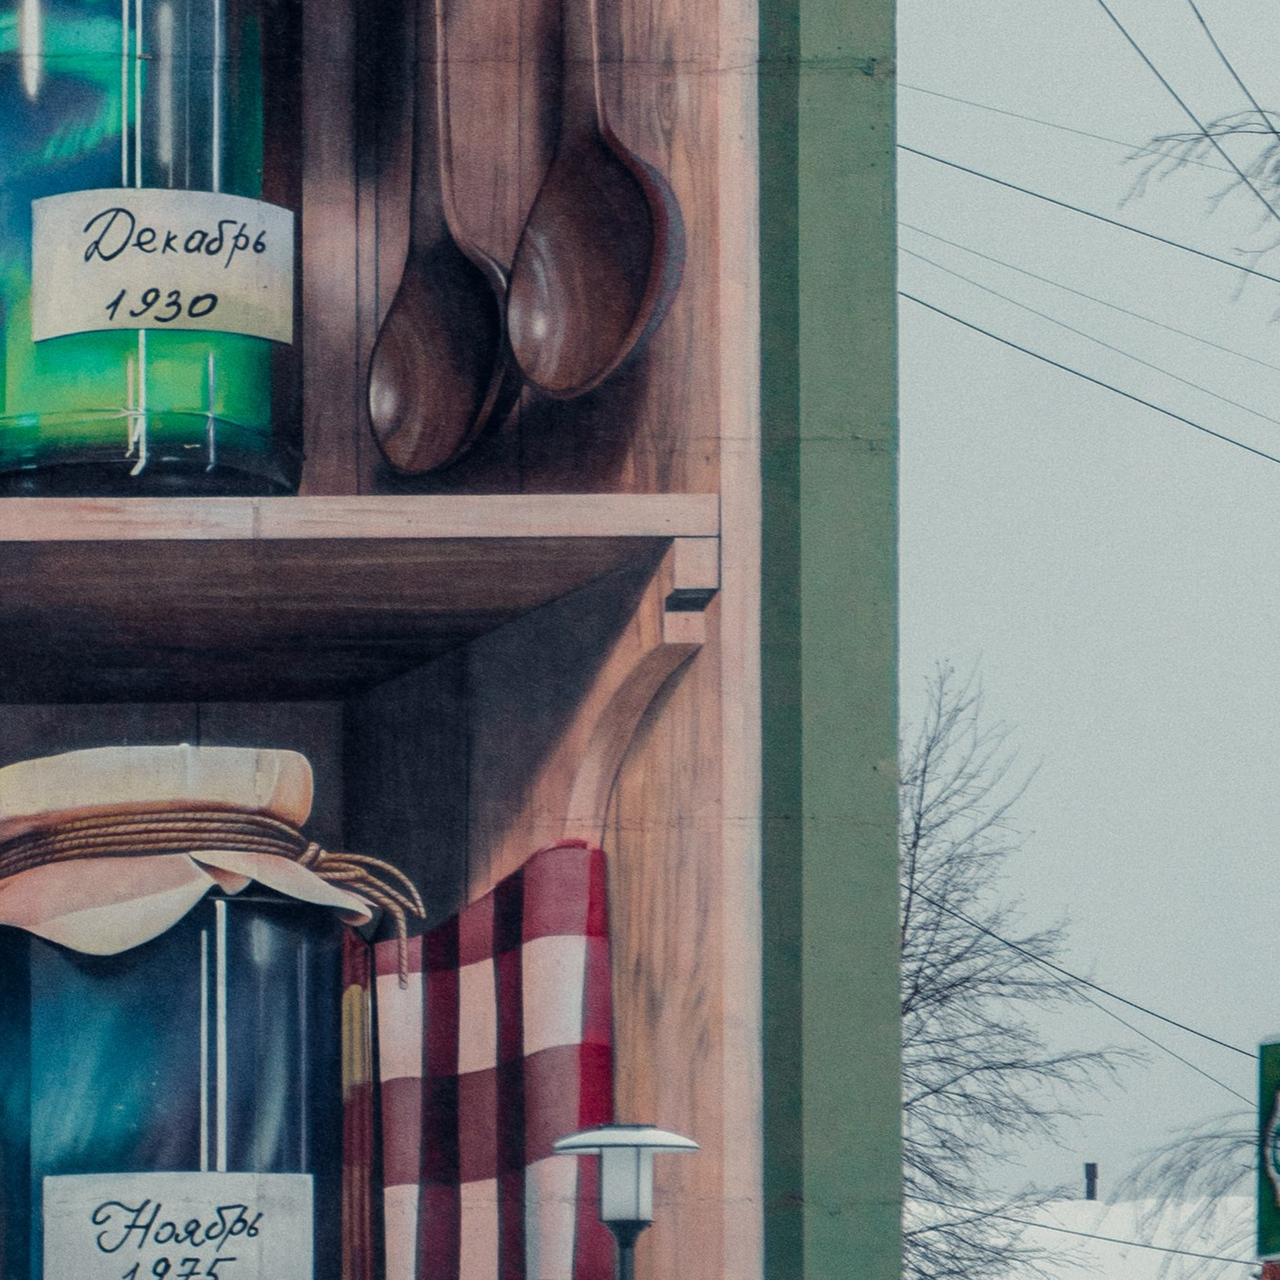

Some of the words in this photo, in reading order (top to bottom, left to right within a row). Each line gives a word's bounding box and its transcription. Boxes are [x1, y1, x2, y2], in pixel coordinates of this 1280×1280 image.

[83, 207, 267, 269] Декабрь
[105, 288, 219, 322] 1930
[91, 1199, 264, 1253] Ноябрь
